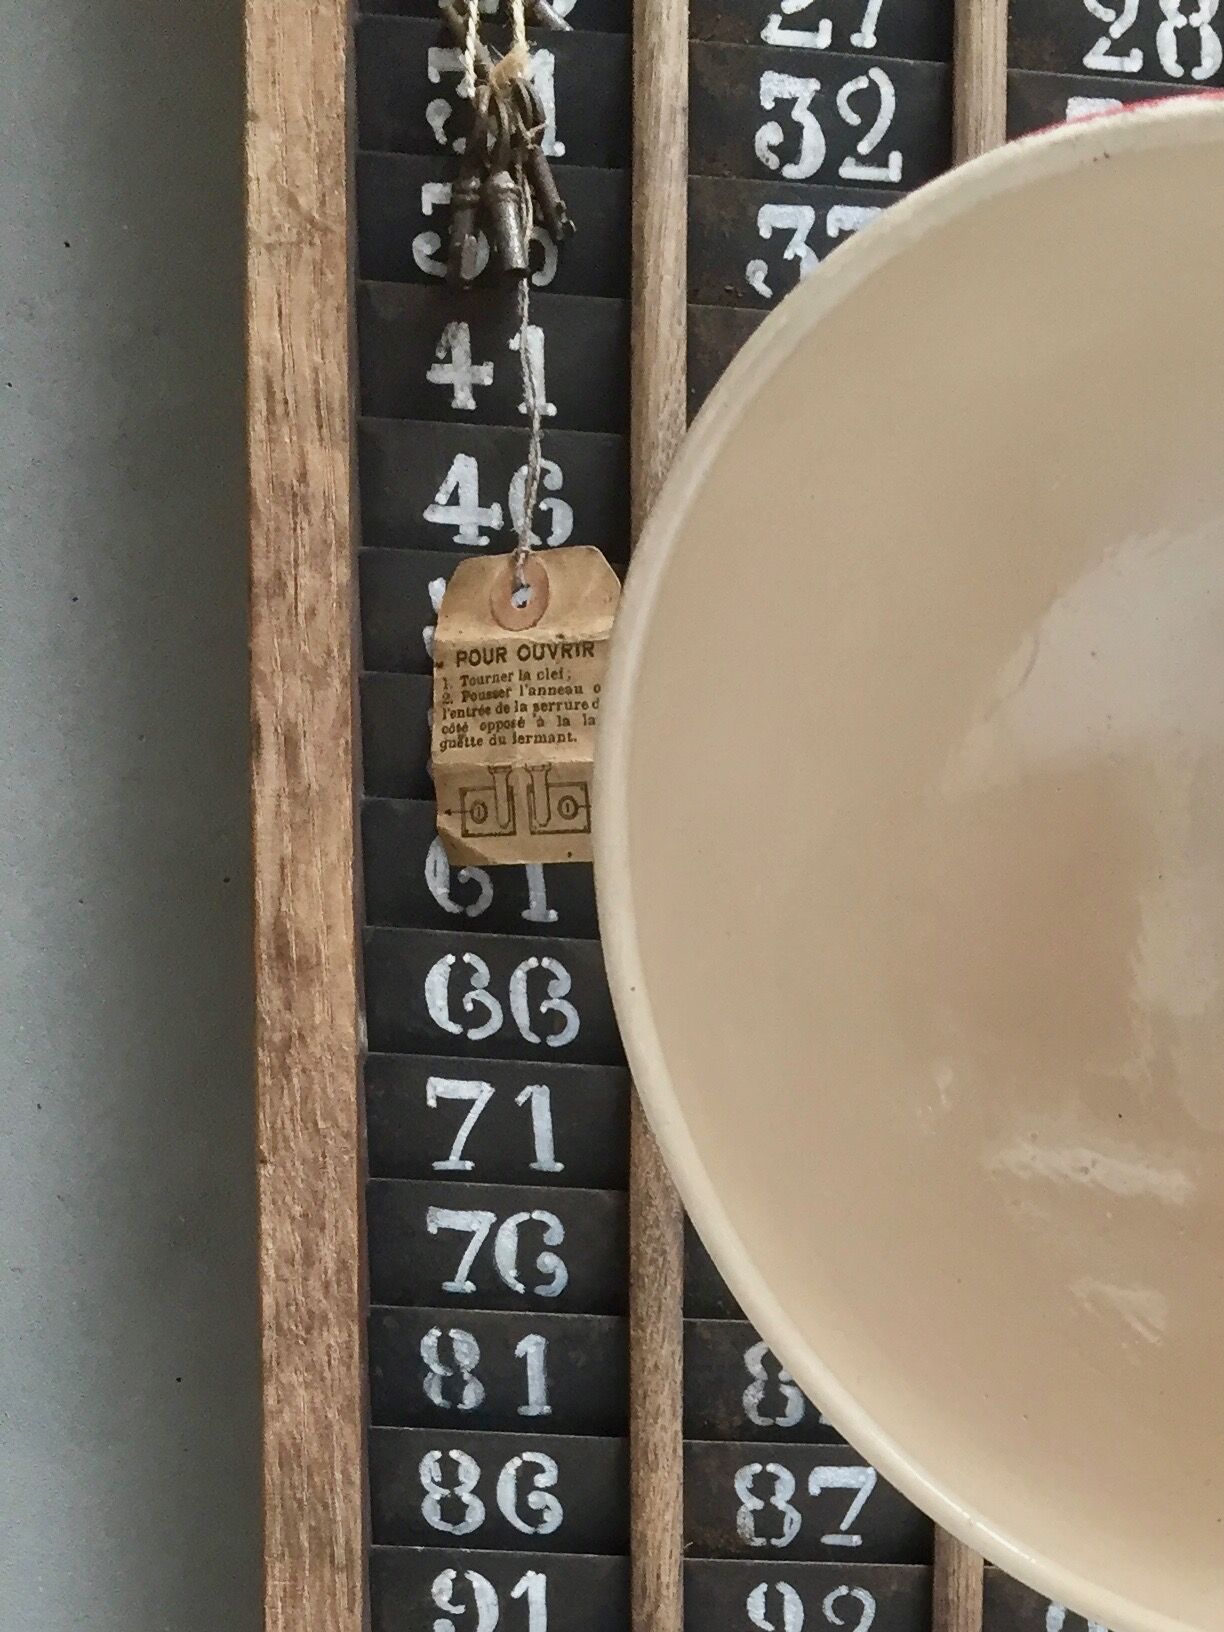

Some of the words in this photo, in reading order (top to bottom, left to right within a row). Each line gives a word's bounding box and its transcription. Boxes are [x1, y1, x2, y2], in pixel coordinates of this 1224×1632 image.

[1083, 0, 1222, 79] 28
[755, 67, 902, 182] 32
[426, 321, 557, 417] 41
[423, 453, 573, 547] 46
[456, 646, 508, 668] POUR
[516, 641, 595, 662] OUVRIR
[460, 671, 514, 687] Tourner
[518, 669, 532, 682] la
[461, 687, 512, 702] Pousser
[519, 684, 584, 697] l'anneau
[442, 704, 491, 720] l'entrée
[495, 701, 511, 714] de
[514, 700, 528, 713] la
[532, 700, 590, 713] serrure
[479, 716, 526, 734] opposé
[556, 714, 571, 728] la
[489, 733, 507, 746] du
[425, 953, 580, 1047] 66
[426, 1077, 564, 1172] 71
[427, 1206, 568, 1297] 76
[420, 1326, 552, 1416] 81
[742, 1341, 832, 1427] 8
[419, 1449, 563, 1535] 86
[734, 1462, 877, 1548] 87
